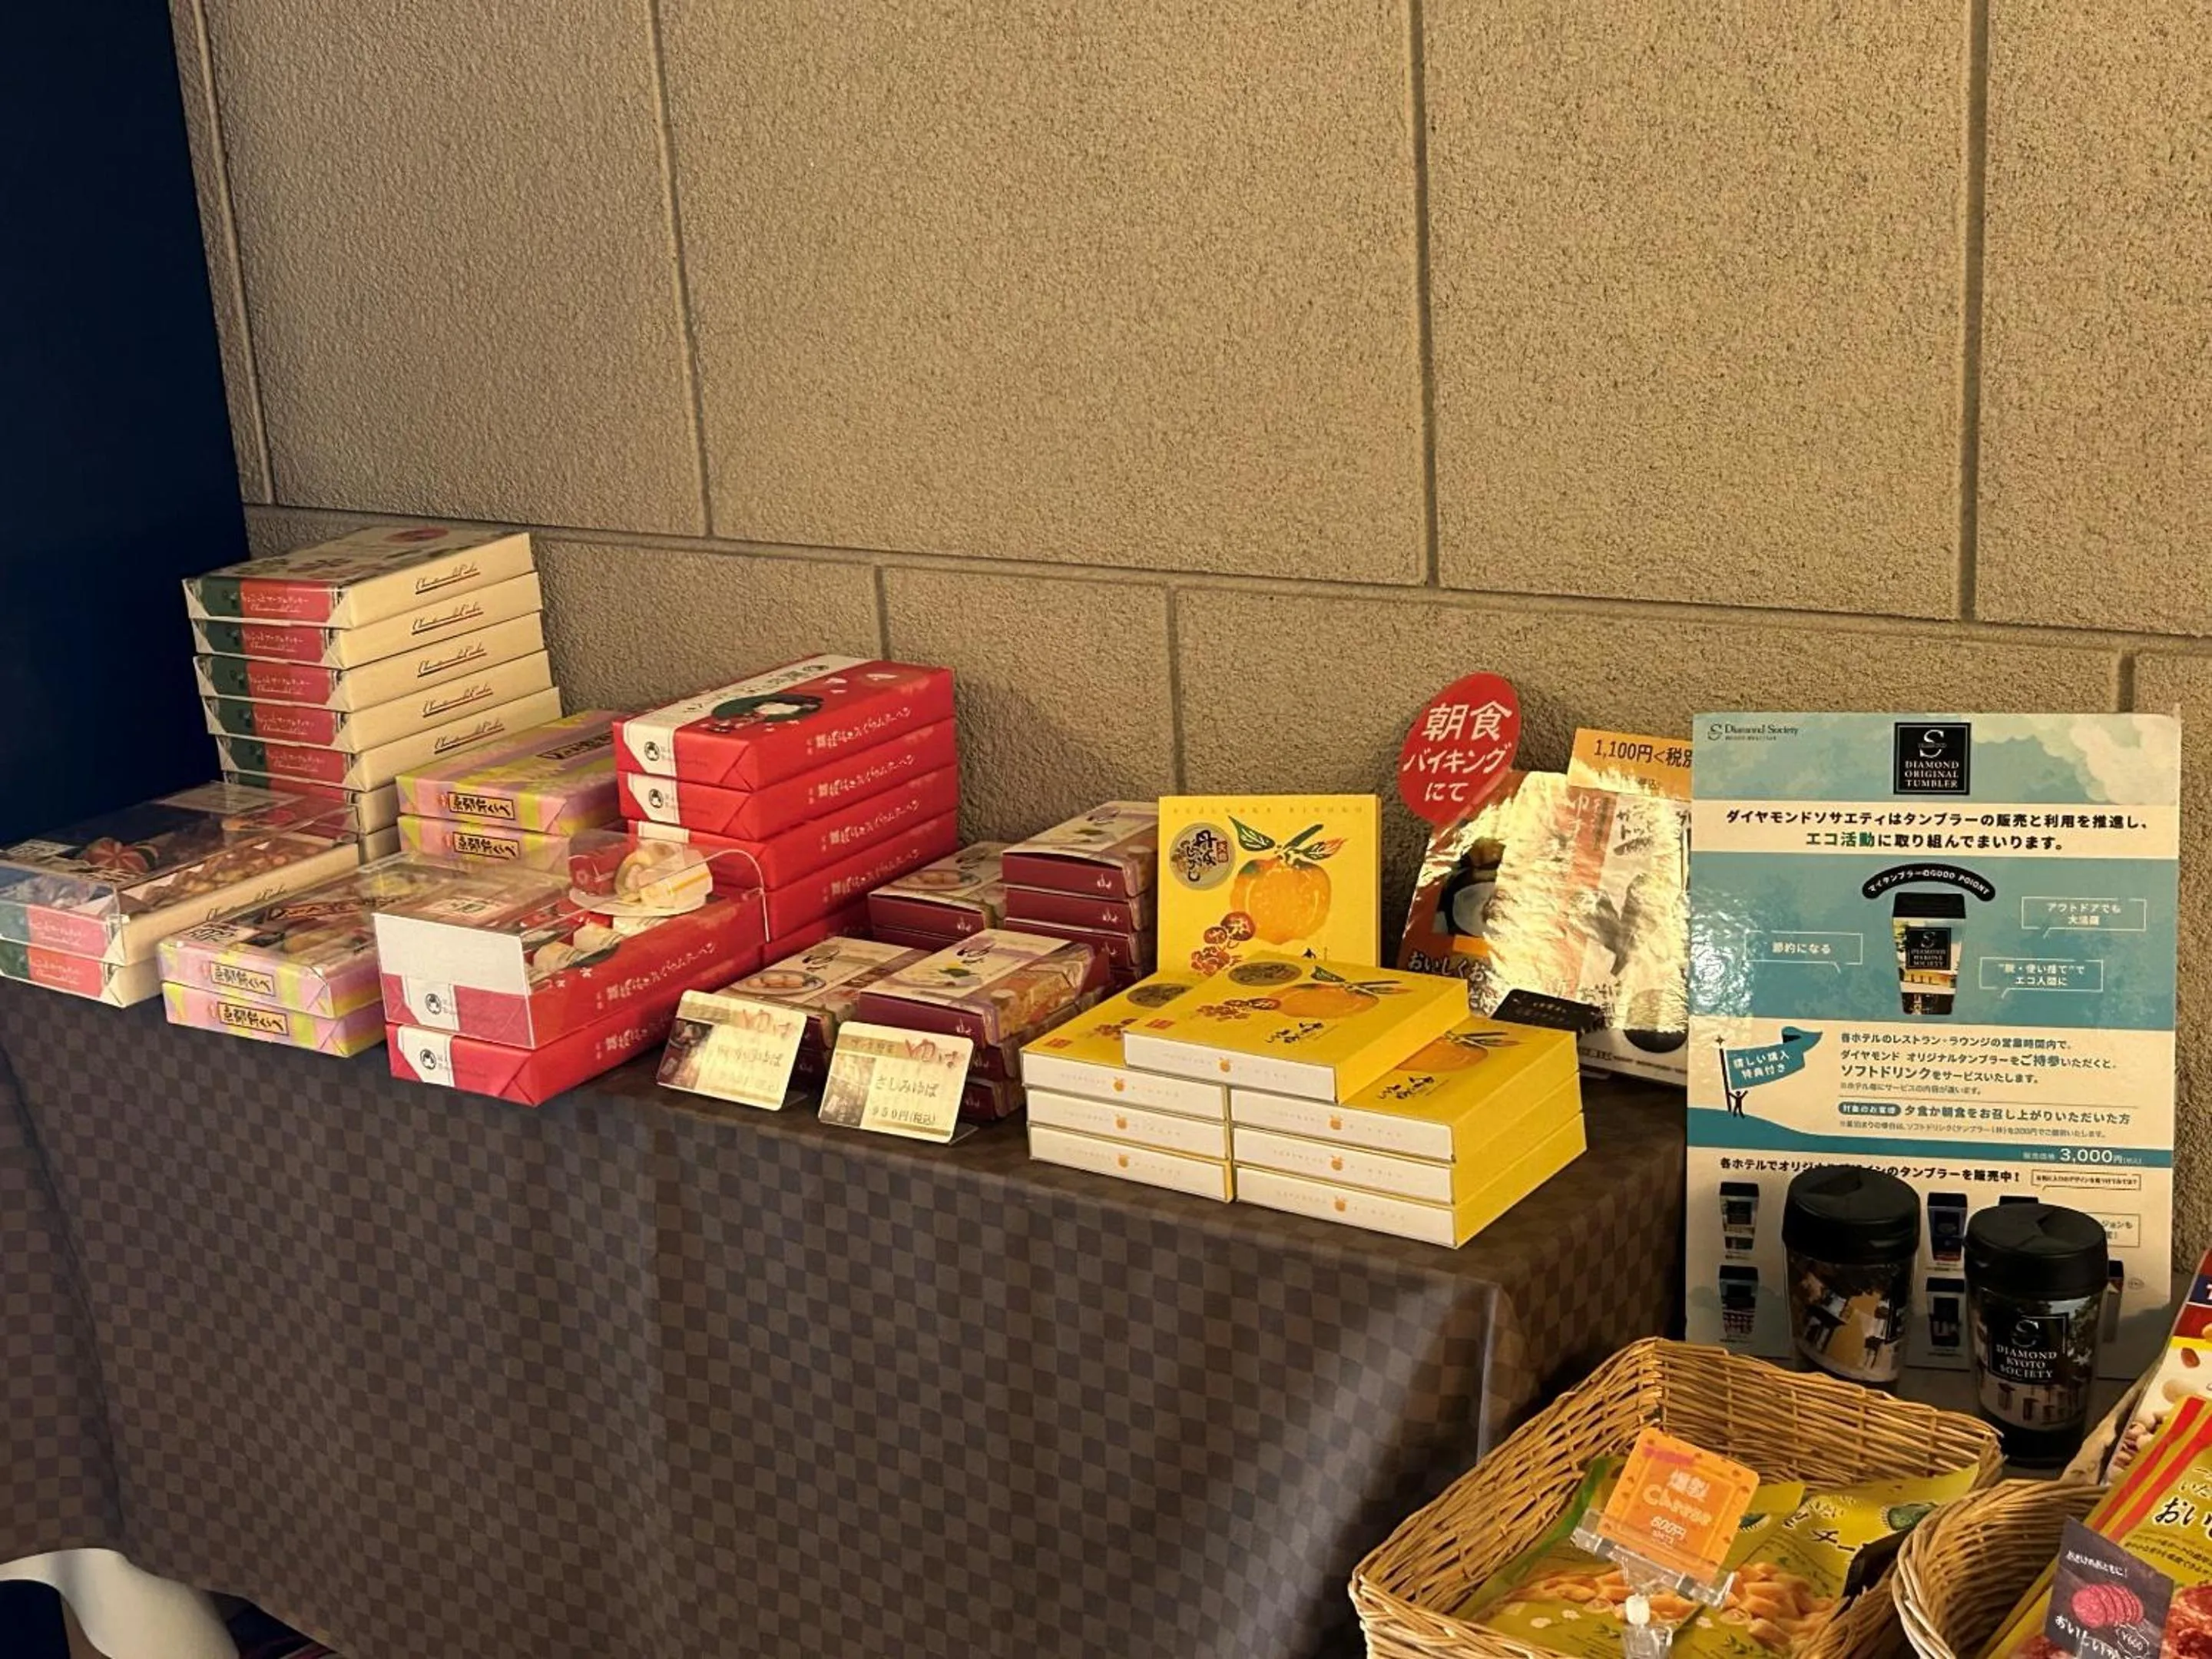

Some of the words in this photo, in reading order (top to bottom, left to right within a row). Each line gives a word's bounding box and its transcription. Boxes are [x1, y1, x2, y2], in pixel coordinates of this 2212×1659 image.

[1420, 700, 1513, 743] 朝食
[1402, 742, 1512, 776] バイキング
[1904, 760, 1959, 769] DIAMOND
[1904, 770, 1959, 779] ORIGINAL
[1906, 779, 1959, 789] TUMBLER
[1425, 780, 1469, 803] にて
[1725, 809, 2149, 831] ダイヤモンドソサエティはタンブラーの販売と利用を推進し、
[1805, 831, 2064, 851] エコ活動に取り組んでまいります。
[1841, 1065, 2038, 1084] ソフトドリンクをサービスいたします。
[1904, 1104, 2131, 1125] 夕食か朝食をお召し上がりいただいた方
[1996, 1344, 2058, 1359] DIAMOND
[1999, 1363, 2054, 1379] SOCIETY
[2005, 1356, 2046, 1369] KYOTO
[1642, 1484, 1712, 1527] Cheese
